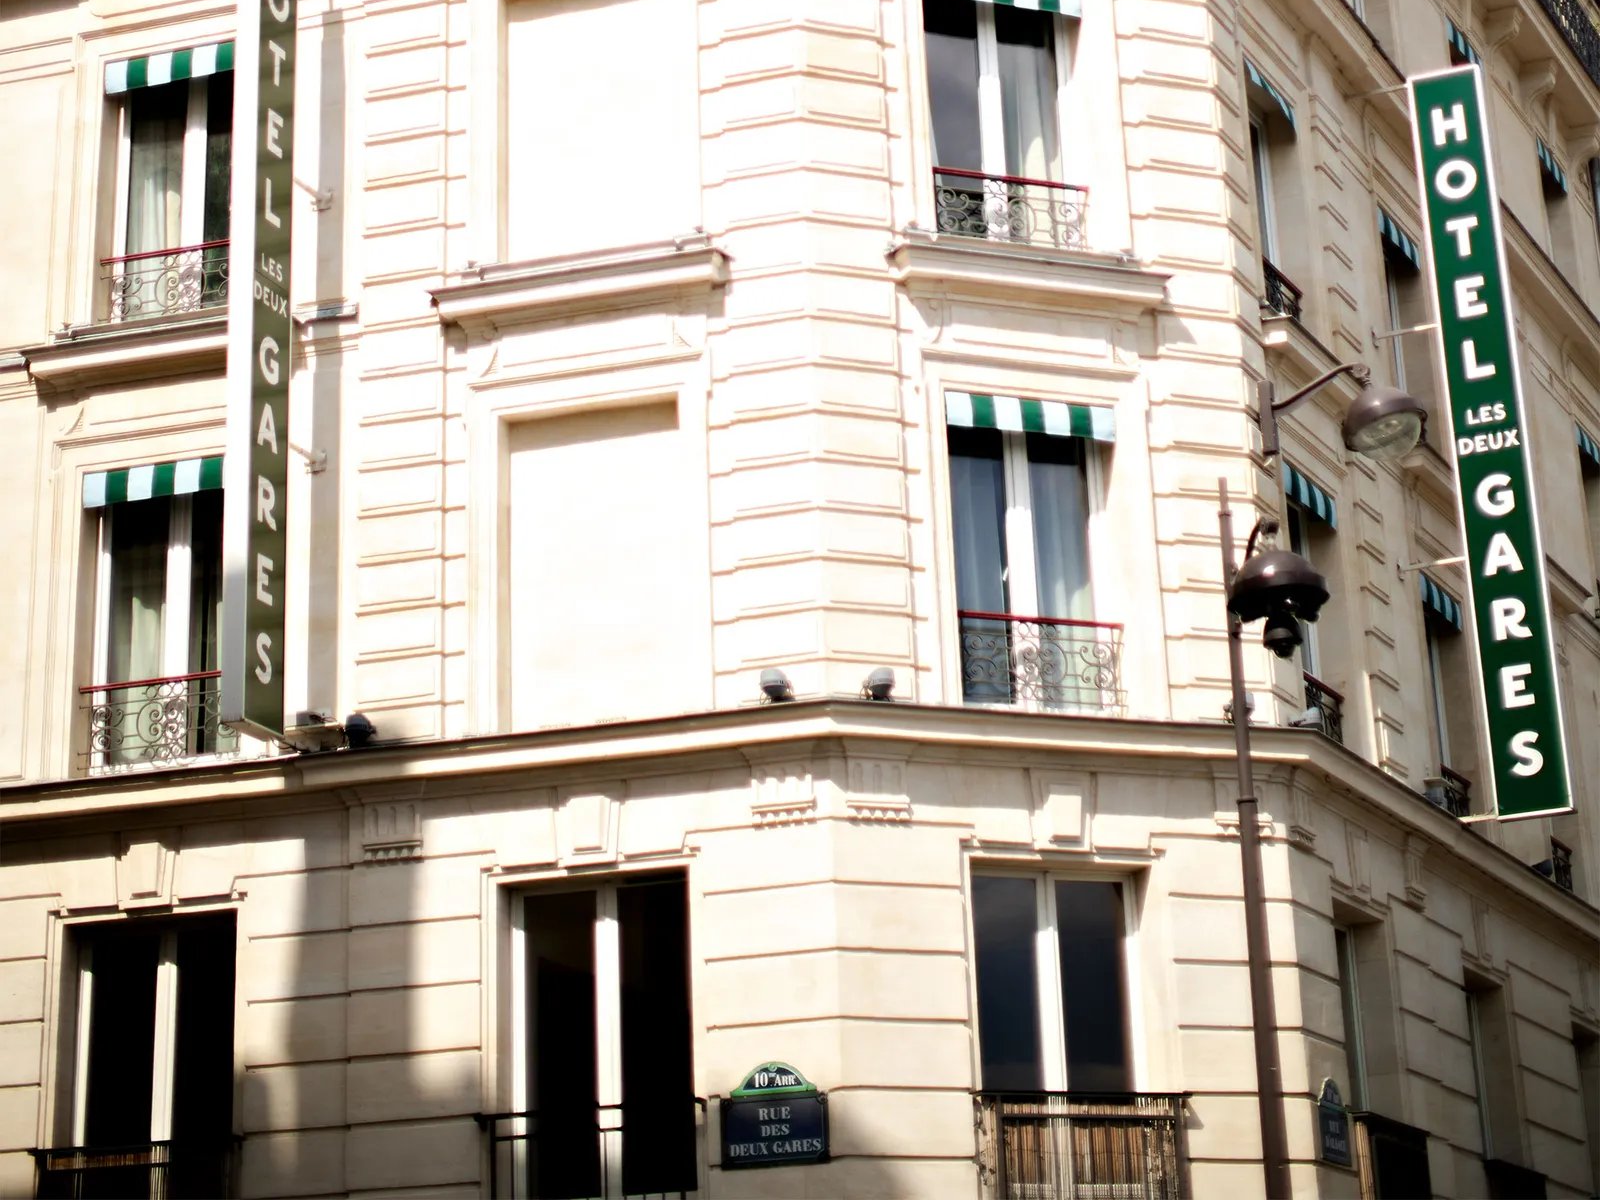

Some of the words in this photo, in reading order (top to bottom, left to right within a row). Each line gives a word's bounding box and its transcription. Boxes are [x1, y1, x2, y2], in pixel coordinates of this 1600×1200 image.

[1430, 103, 1496, 380] HOTEL
[260, 252, 284, 283] LES
[253, 279, 288, 318] DEUX
[1465, 403, 1507, 426] LES
[1457, 428, 1521, 456] DEUX
[255, 336, 281, 685] GARES
[1475, 473, 1545, 777] GARES
[758, 1106, 791, 1121] RUE
[761, 1124, 790, 1137] DES
[730, 1142, 769, 1157] DEUX
[772, 1138, 822, 1154] GARES
